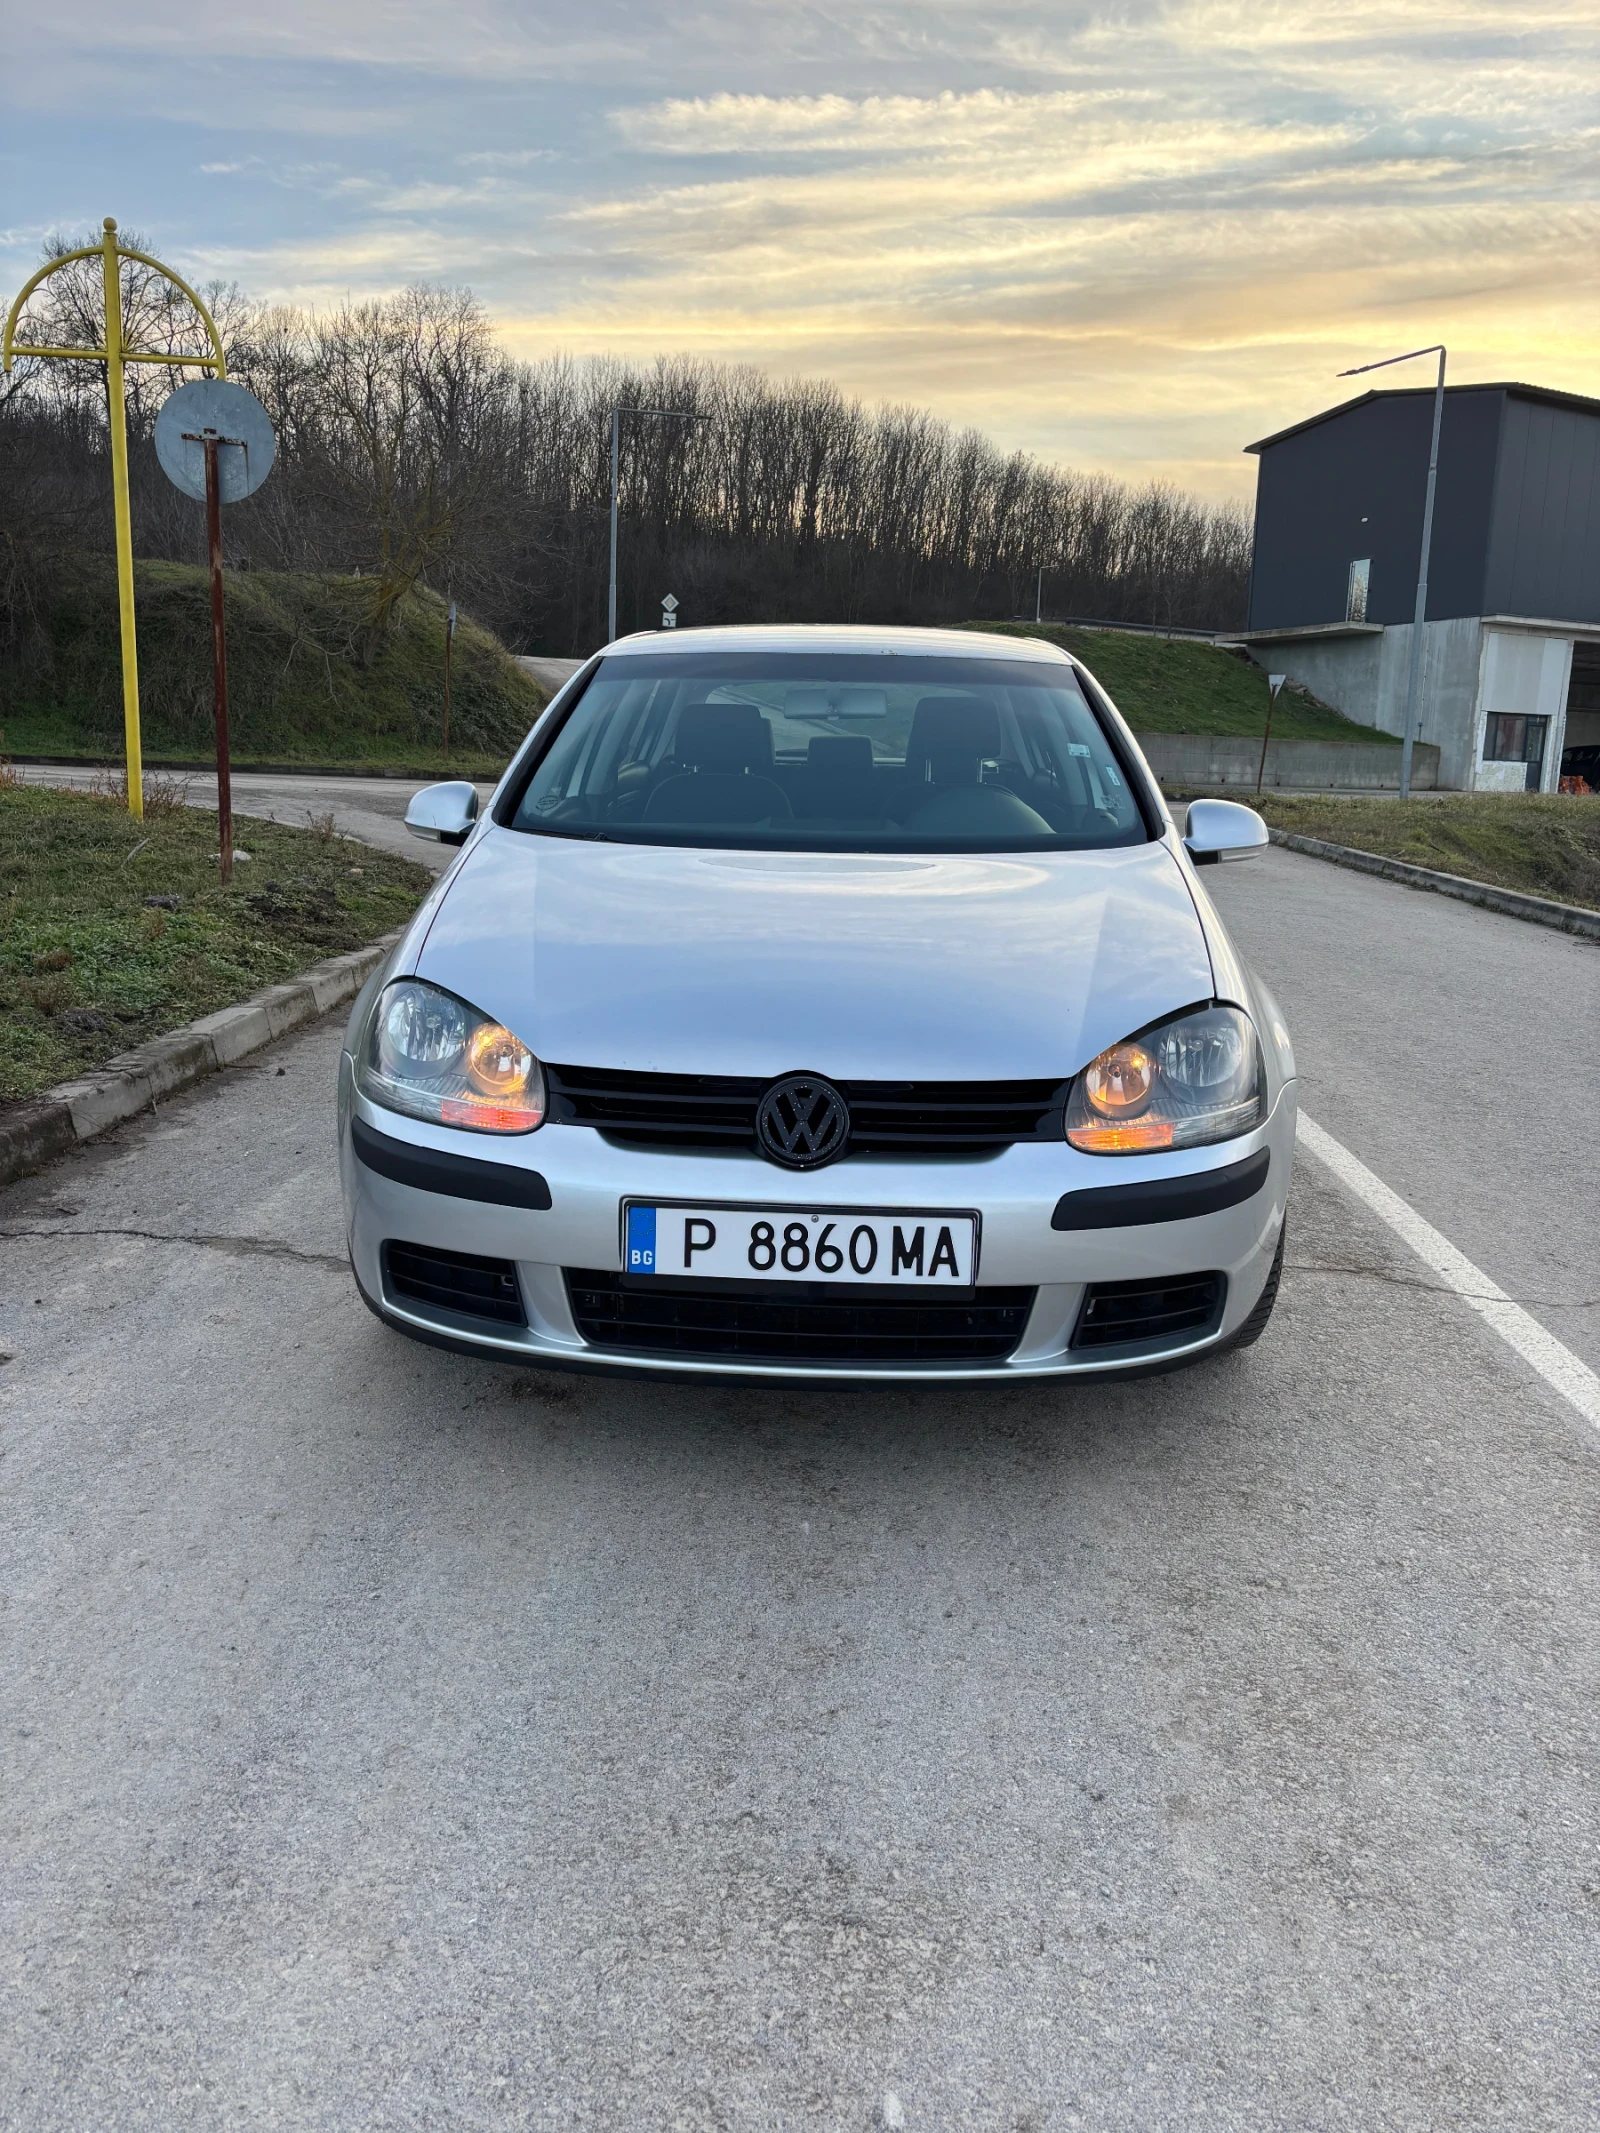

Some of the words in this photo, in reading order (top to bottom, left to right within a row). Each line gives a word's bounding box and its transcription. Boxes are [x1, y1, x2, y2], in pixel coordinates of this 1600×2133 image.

[631, 1249, 653, 1266] BG
[683, 1217, 717, 1268] P
[747, 1220, 878, 1275] 8860
[891, 1225, 960, 1277] MA
